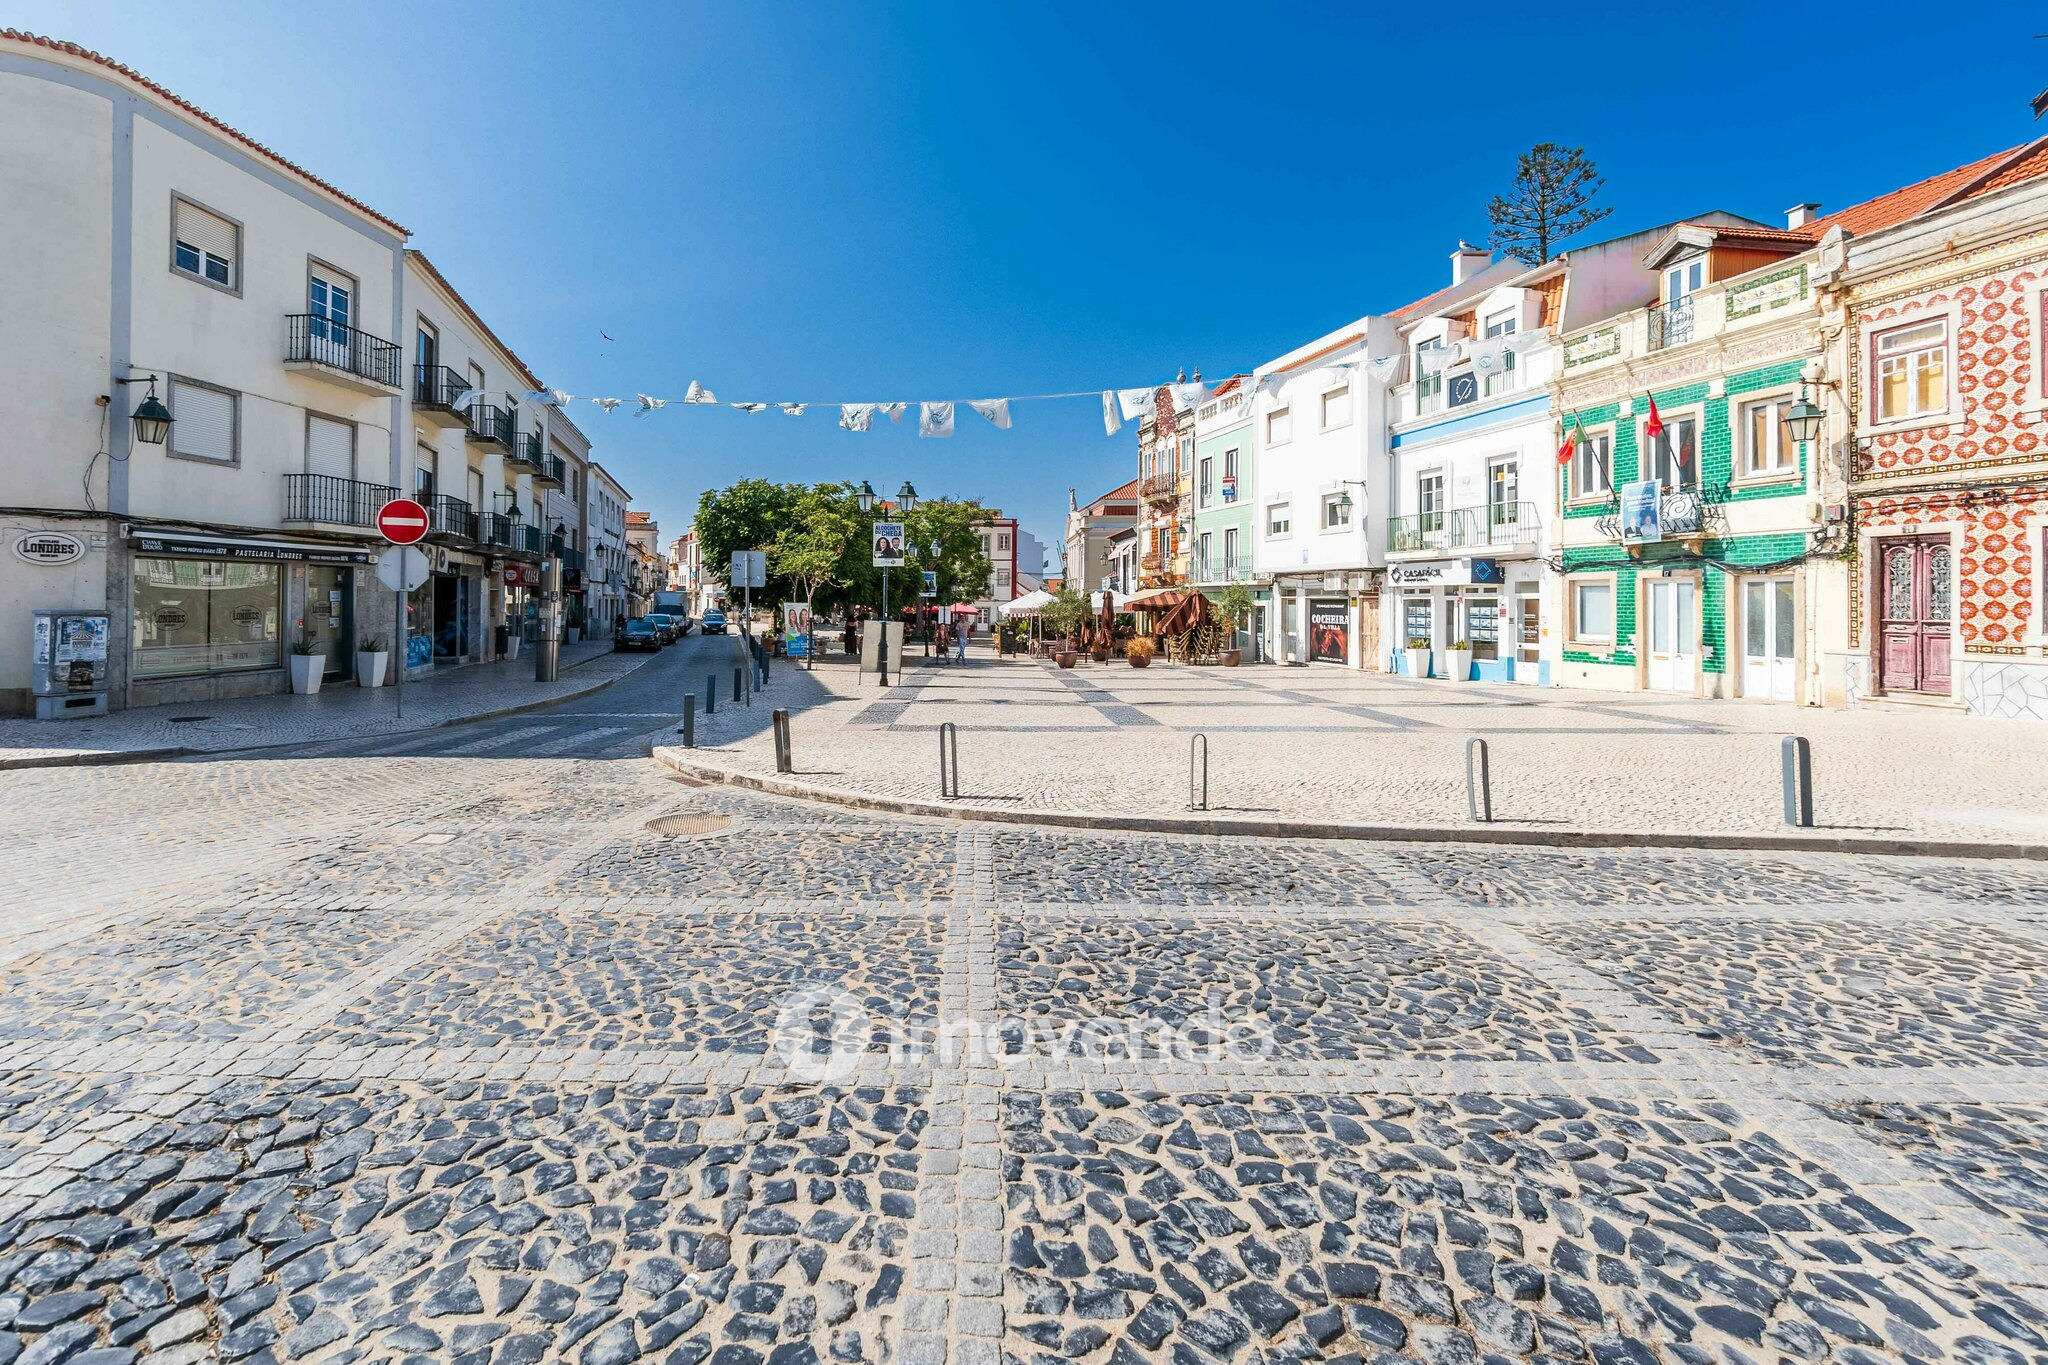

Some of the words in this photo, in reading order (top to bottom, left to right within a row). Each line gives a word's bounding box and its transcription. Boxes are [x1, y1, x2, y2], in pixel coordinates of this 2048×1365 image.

[23, 536, 75, 554] LONDRES
[235, 549, 275, 559] PASTELARIA
[276, 549, 303, 560] LONDRES
[1311, 613, 1349, 625] COCHEIRA
